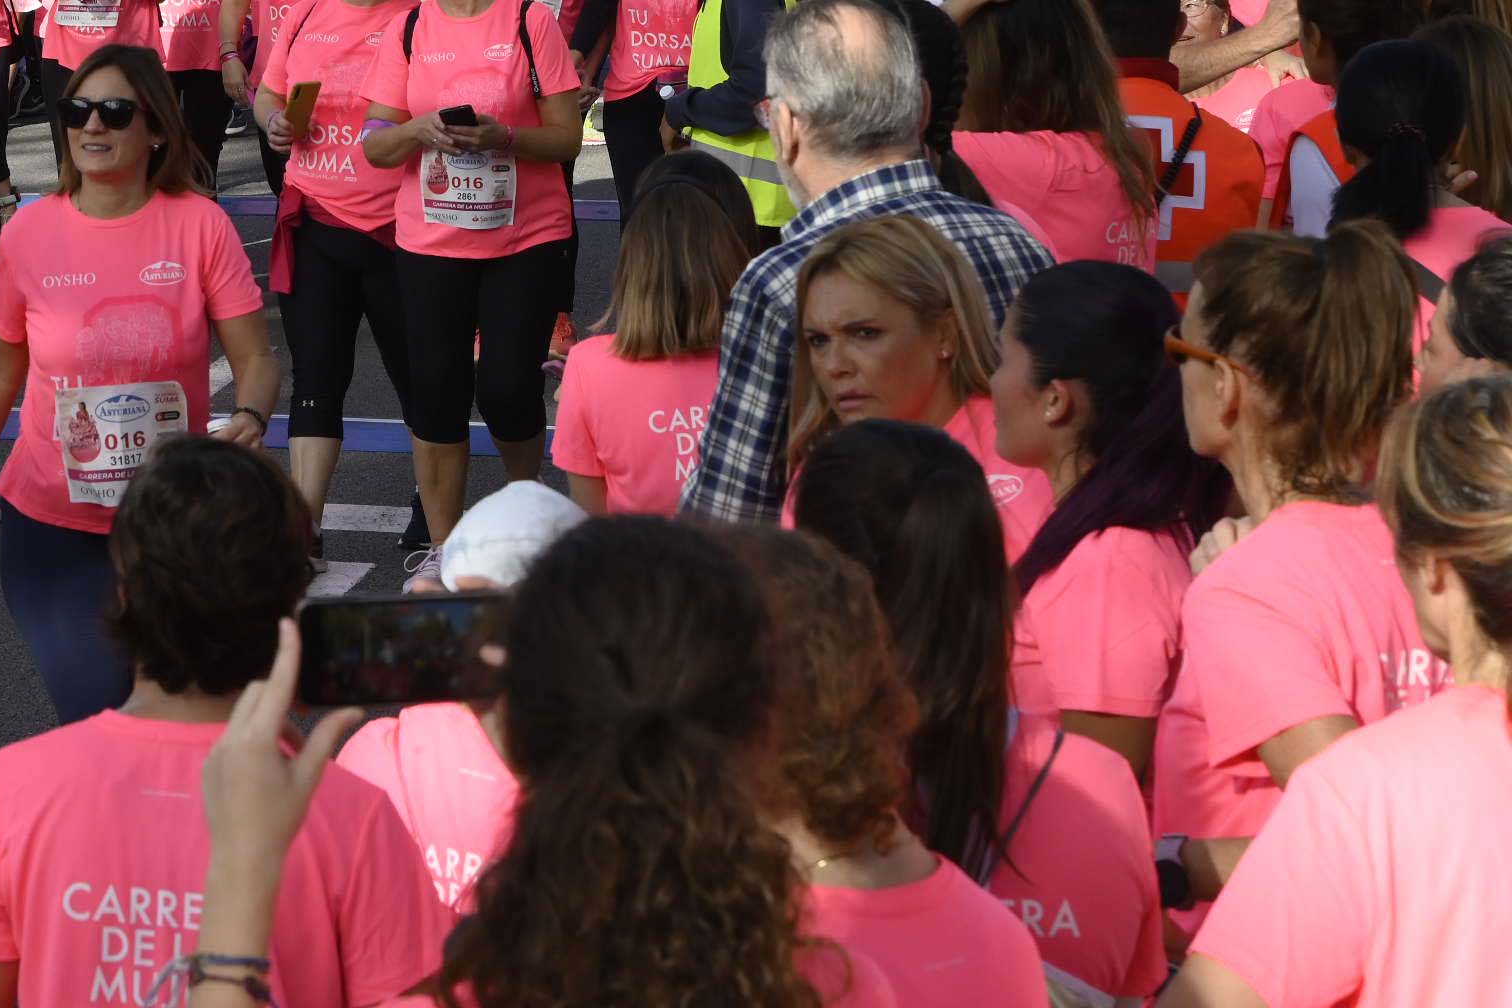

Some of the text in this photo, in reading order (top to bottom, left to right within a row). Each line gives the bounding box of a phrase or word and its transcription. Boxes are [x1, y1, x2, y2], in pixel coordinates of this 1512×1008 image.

[627, 8, 648, 26] TU
[304, 33, 340, 44] OYSHO
[631, 52, 687, 69] SUMA
[297, 150, 356, 175] SUMA
[451, 176, 484, 190] 016
[457, 192, 477, 201] 2861
[42, 272, 97, 289] OYSHO
[99, 404, 147, 418] ASTURIANA
[648, 404, 712, 434] CAR
[104, 430, 146, 450] 016
[109, 452, 143, 467] 31817
[114, 471, 126, 479] DE
[101, 925, 155, 968] DE
